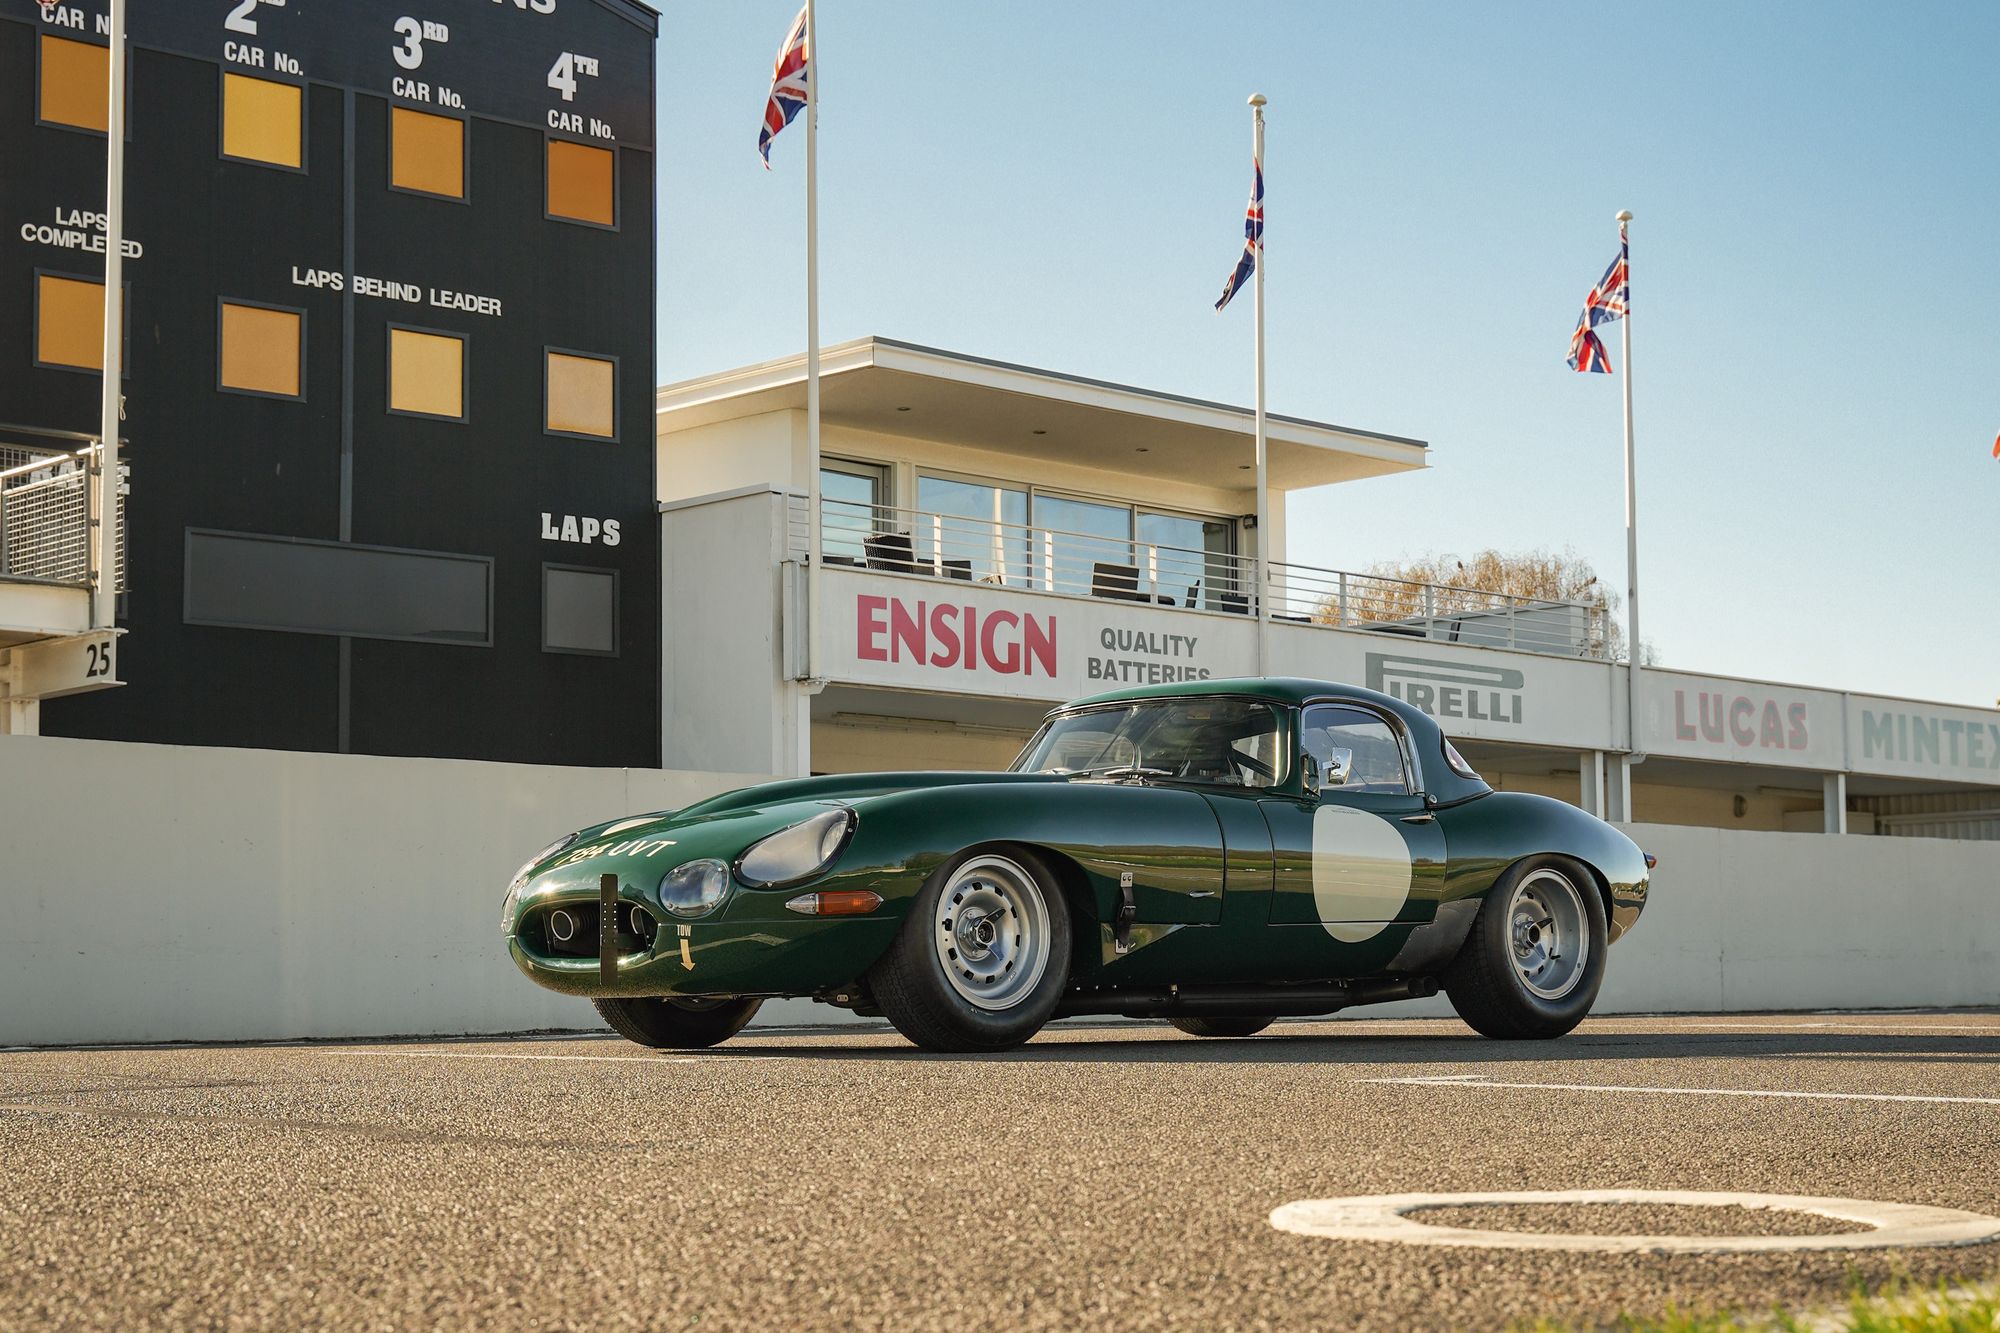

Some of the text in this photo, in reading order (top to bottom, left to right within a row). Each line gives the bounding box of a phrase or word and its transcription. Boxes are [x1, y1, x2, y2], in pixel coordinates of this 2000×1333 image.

[41, 3, 128, 40] CAR N.
[224, 40, 304, 77] CAR No.
[392, 16, 449, 70] 3RD
[392, 76, 467, 110] CAR No.
[547, 51, 600, 102] 4TH
[547, 108, 616, 141] CAR No.
[55, 206, 108, 232] LAPS
[20, 223, 144, 259] COMPLEED
[292, 265, 502, 317] LAPS BEHIND LEADER
[541, 512, 621, 546] LAPS
[856, 594, 1057, 678] ENSIGN
[1100, 627, 1198, 658] QUALITY
[86, 641, 111, 678] 25
[1365, 651, 1525, 724] PIRELLI
[1674, 690, 1809, 751] LUCAS
[607, 840, 678, 858] UVT
[676, 924, 692, 937] TOW
